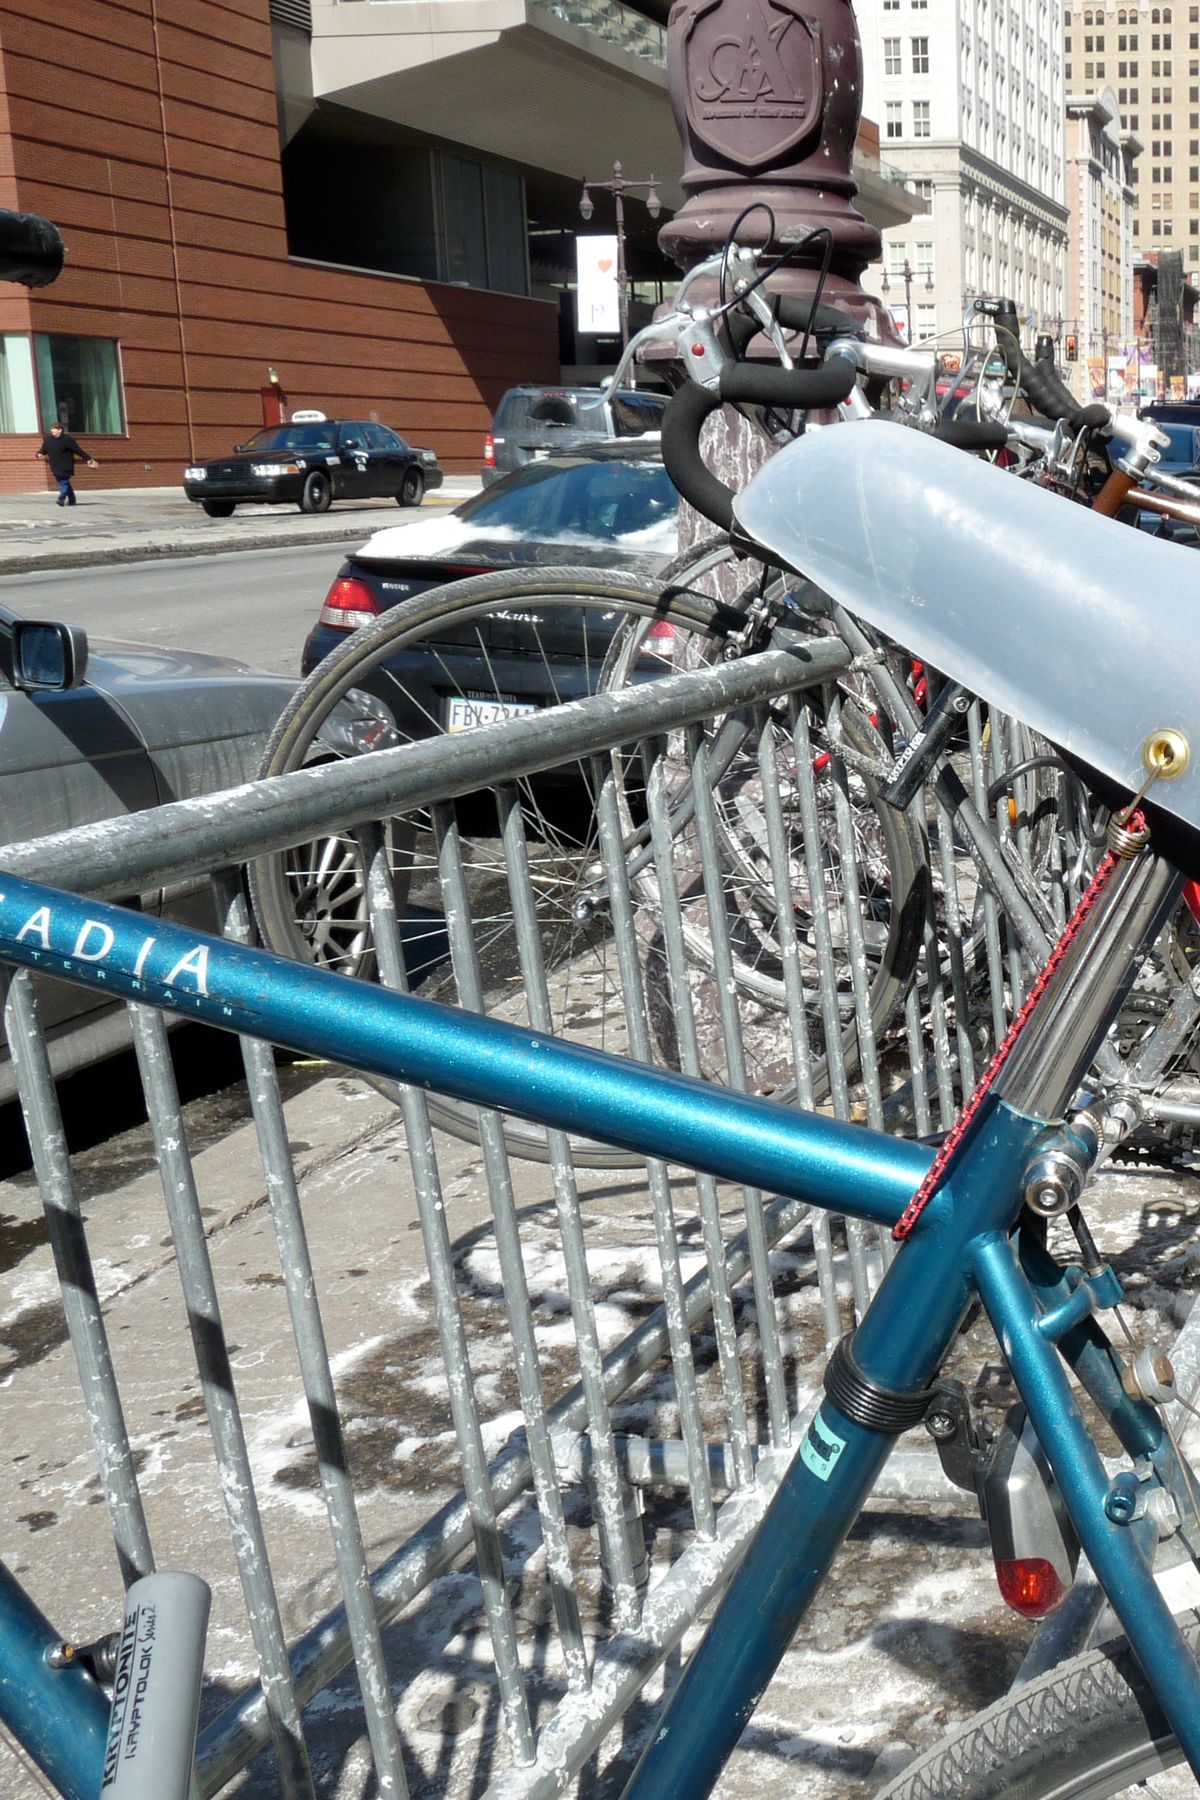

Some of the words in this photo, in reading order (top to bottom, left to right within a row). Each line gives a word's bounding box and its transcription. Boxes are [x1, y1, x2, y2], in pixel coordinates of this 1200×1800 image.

[0, 894, 209, 998] ADIA
[31, 950, 232, 1016] TERRAIN
[102, 1611, 137, 1789] KRYPTONITE
[125, 1645, 153, 1760] KRYPTOLOK
